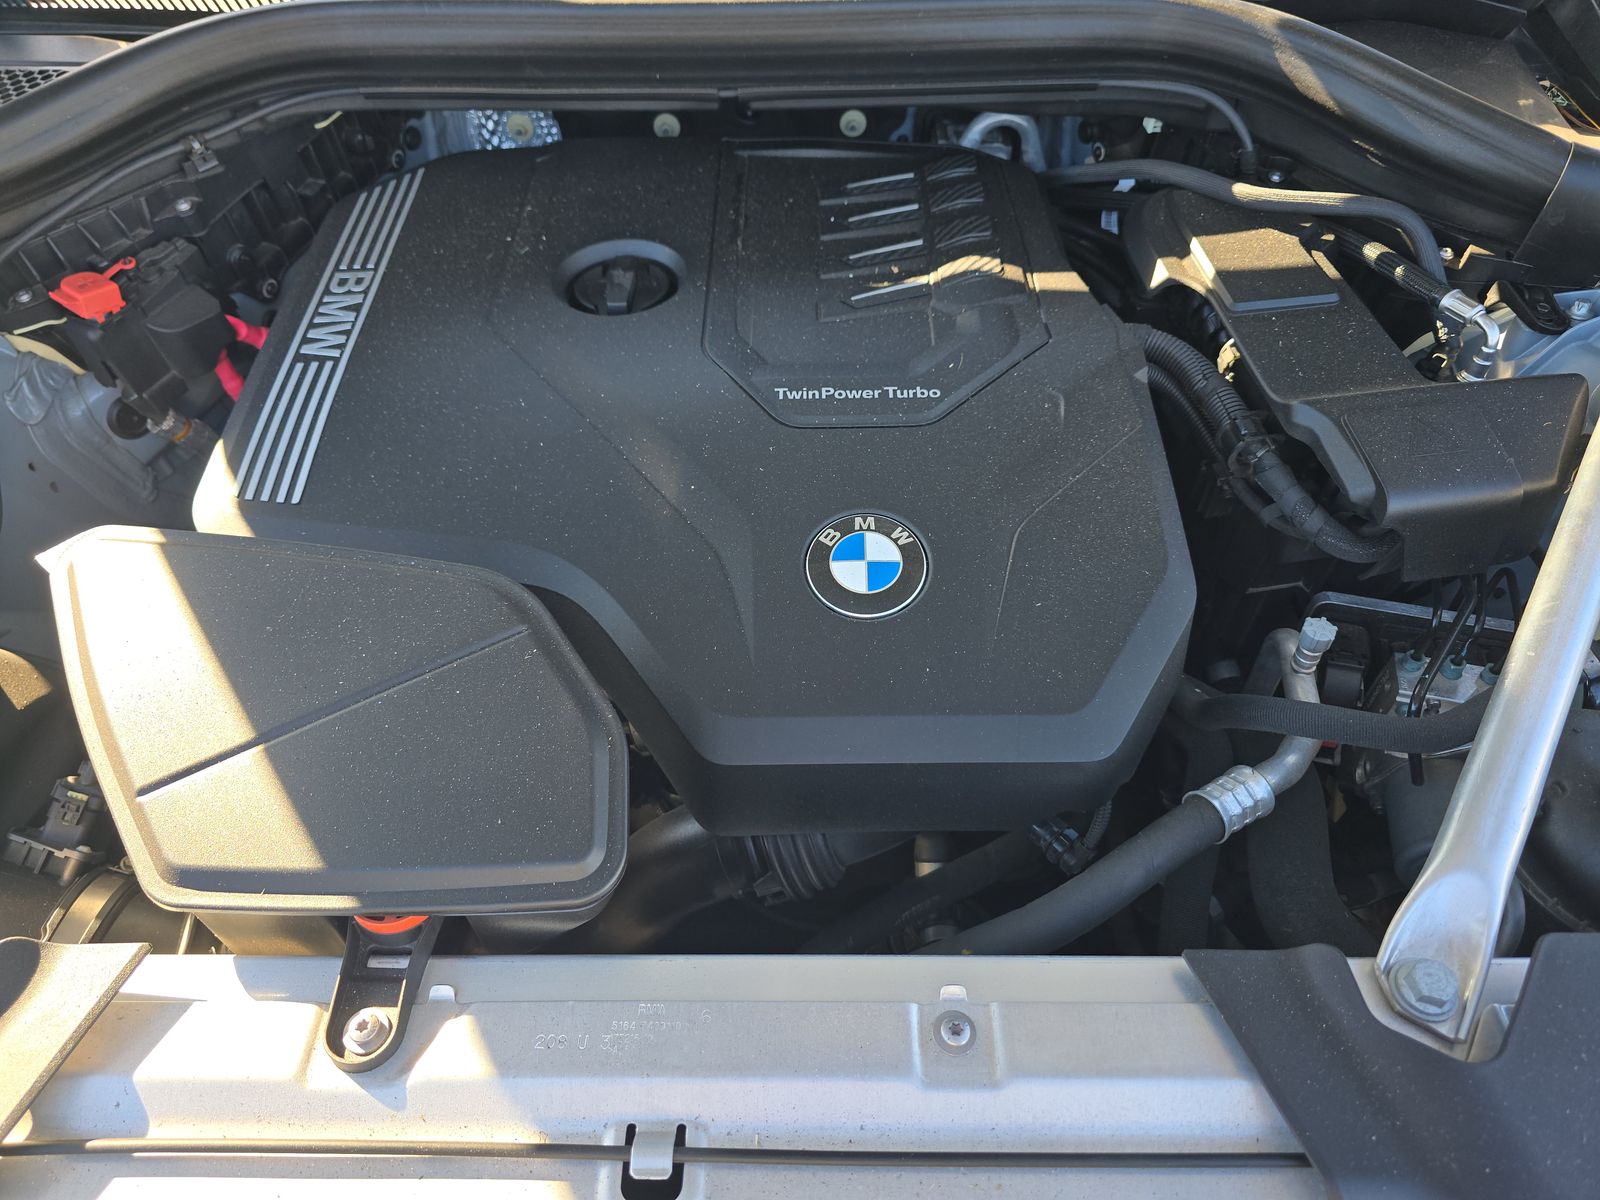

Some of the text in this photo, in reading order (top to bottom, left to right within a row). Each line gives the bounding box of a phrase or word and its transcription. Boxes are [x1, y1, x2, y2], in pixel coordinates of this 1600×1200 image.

[300, 271, 374, 358] BMW
[775, 386, 941, 400] TwinPower Turbo
[818, 516, 914, 547] BMW
[534, 1033, 568, 1050] 208
